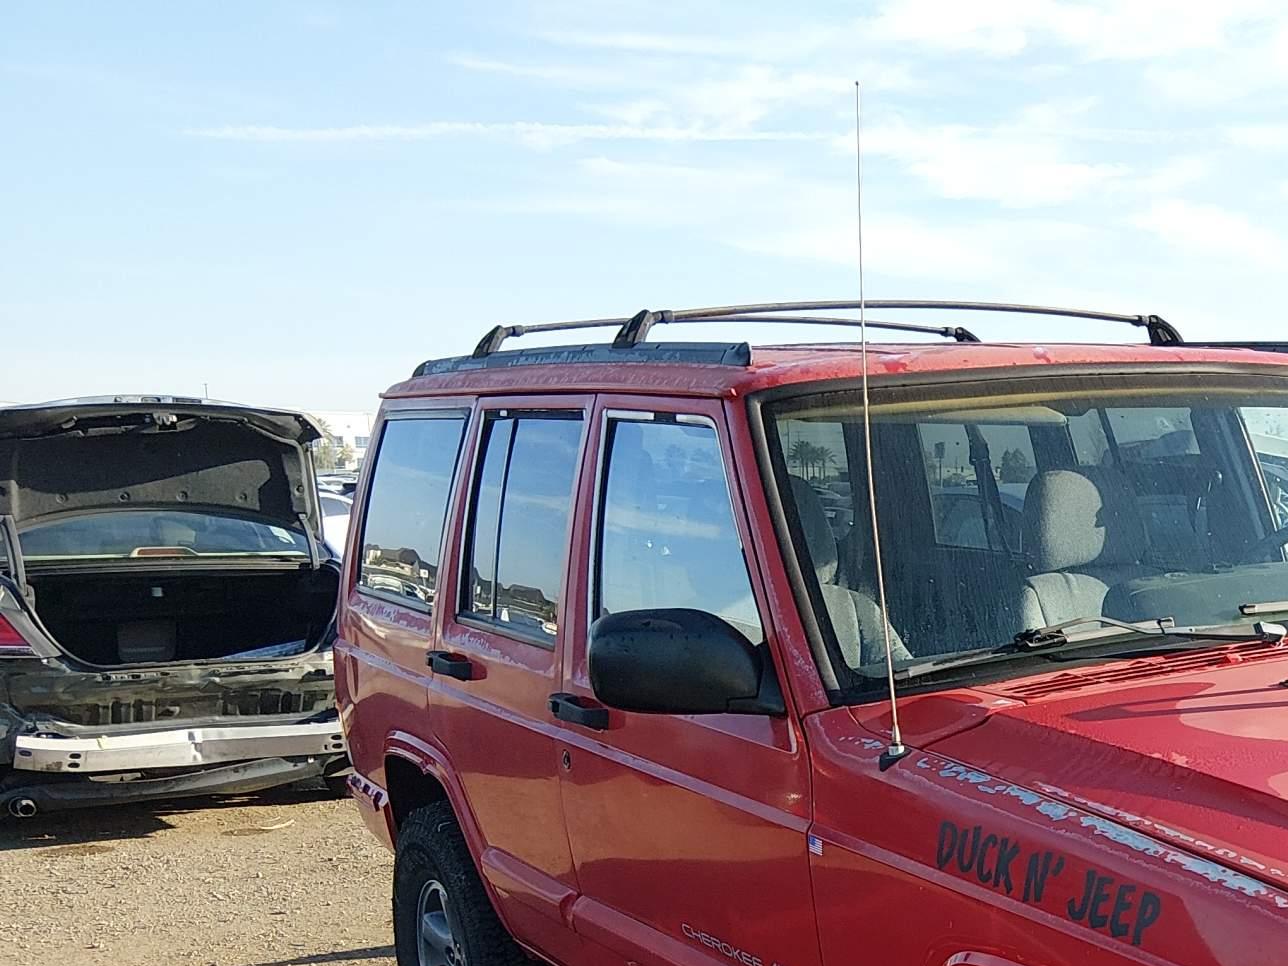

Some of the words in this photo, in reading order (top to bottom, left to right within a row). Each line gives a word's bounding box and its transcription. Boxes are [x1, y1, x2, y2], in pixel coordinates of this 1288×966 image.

[936, 820, 1019, 894] DUCK
[1023, 852, 1064, 903] N'
[1067, 870, 1161, 946] JEEP
